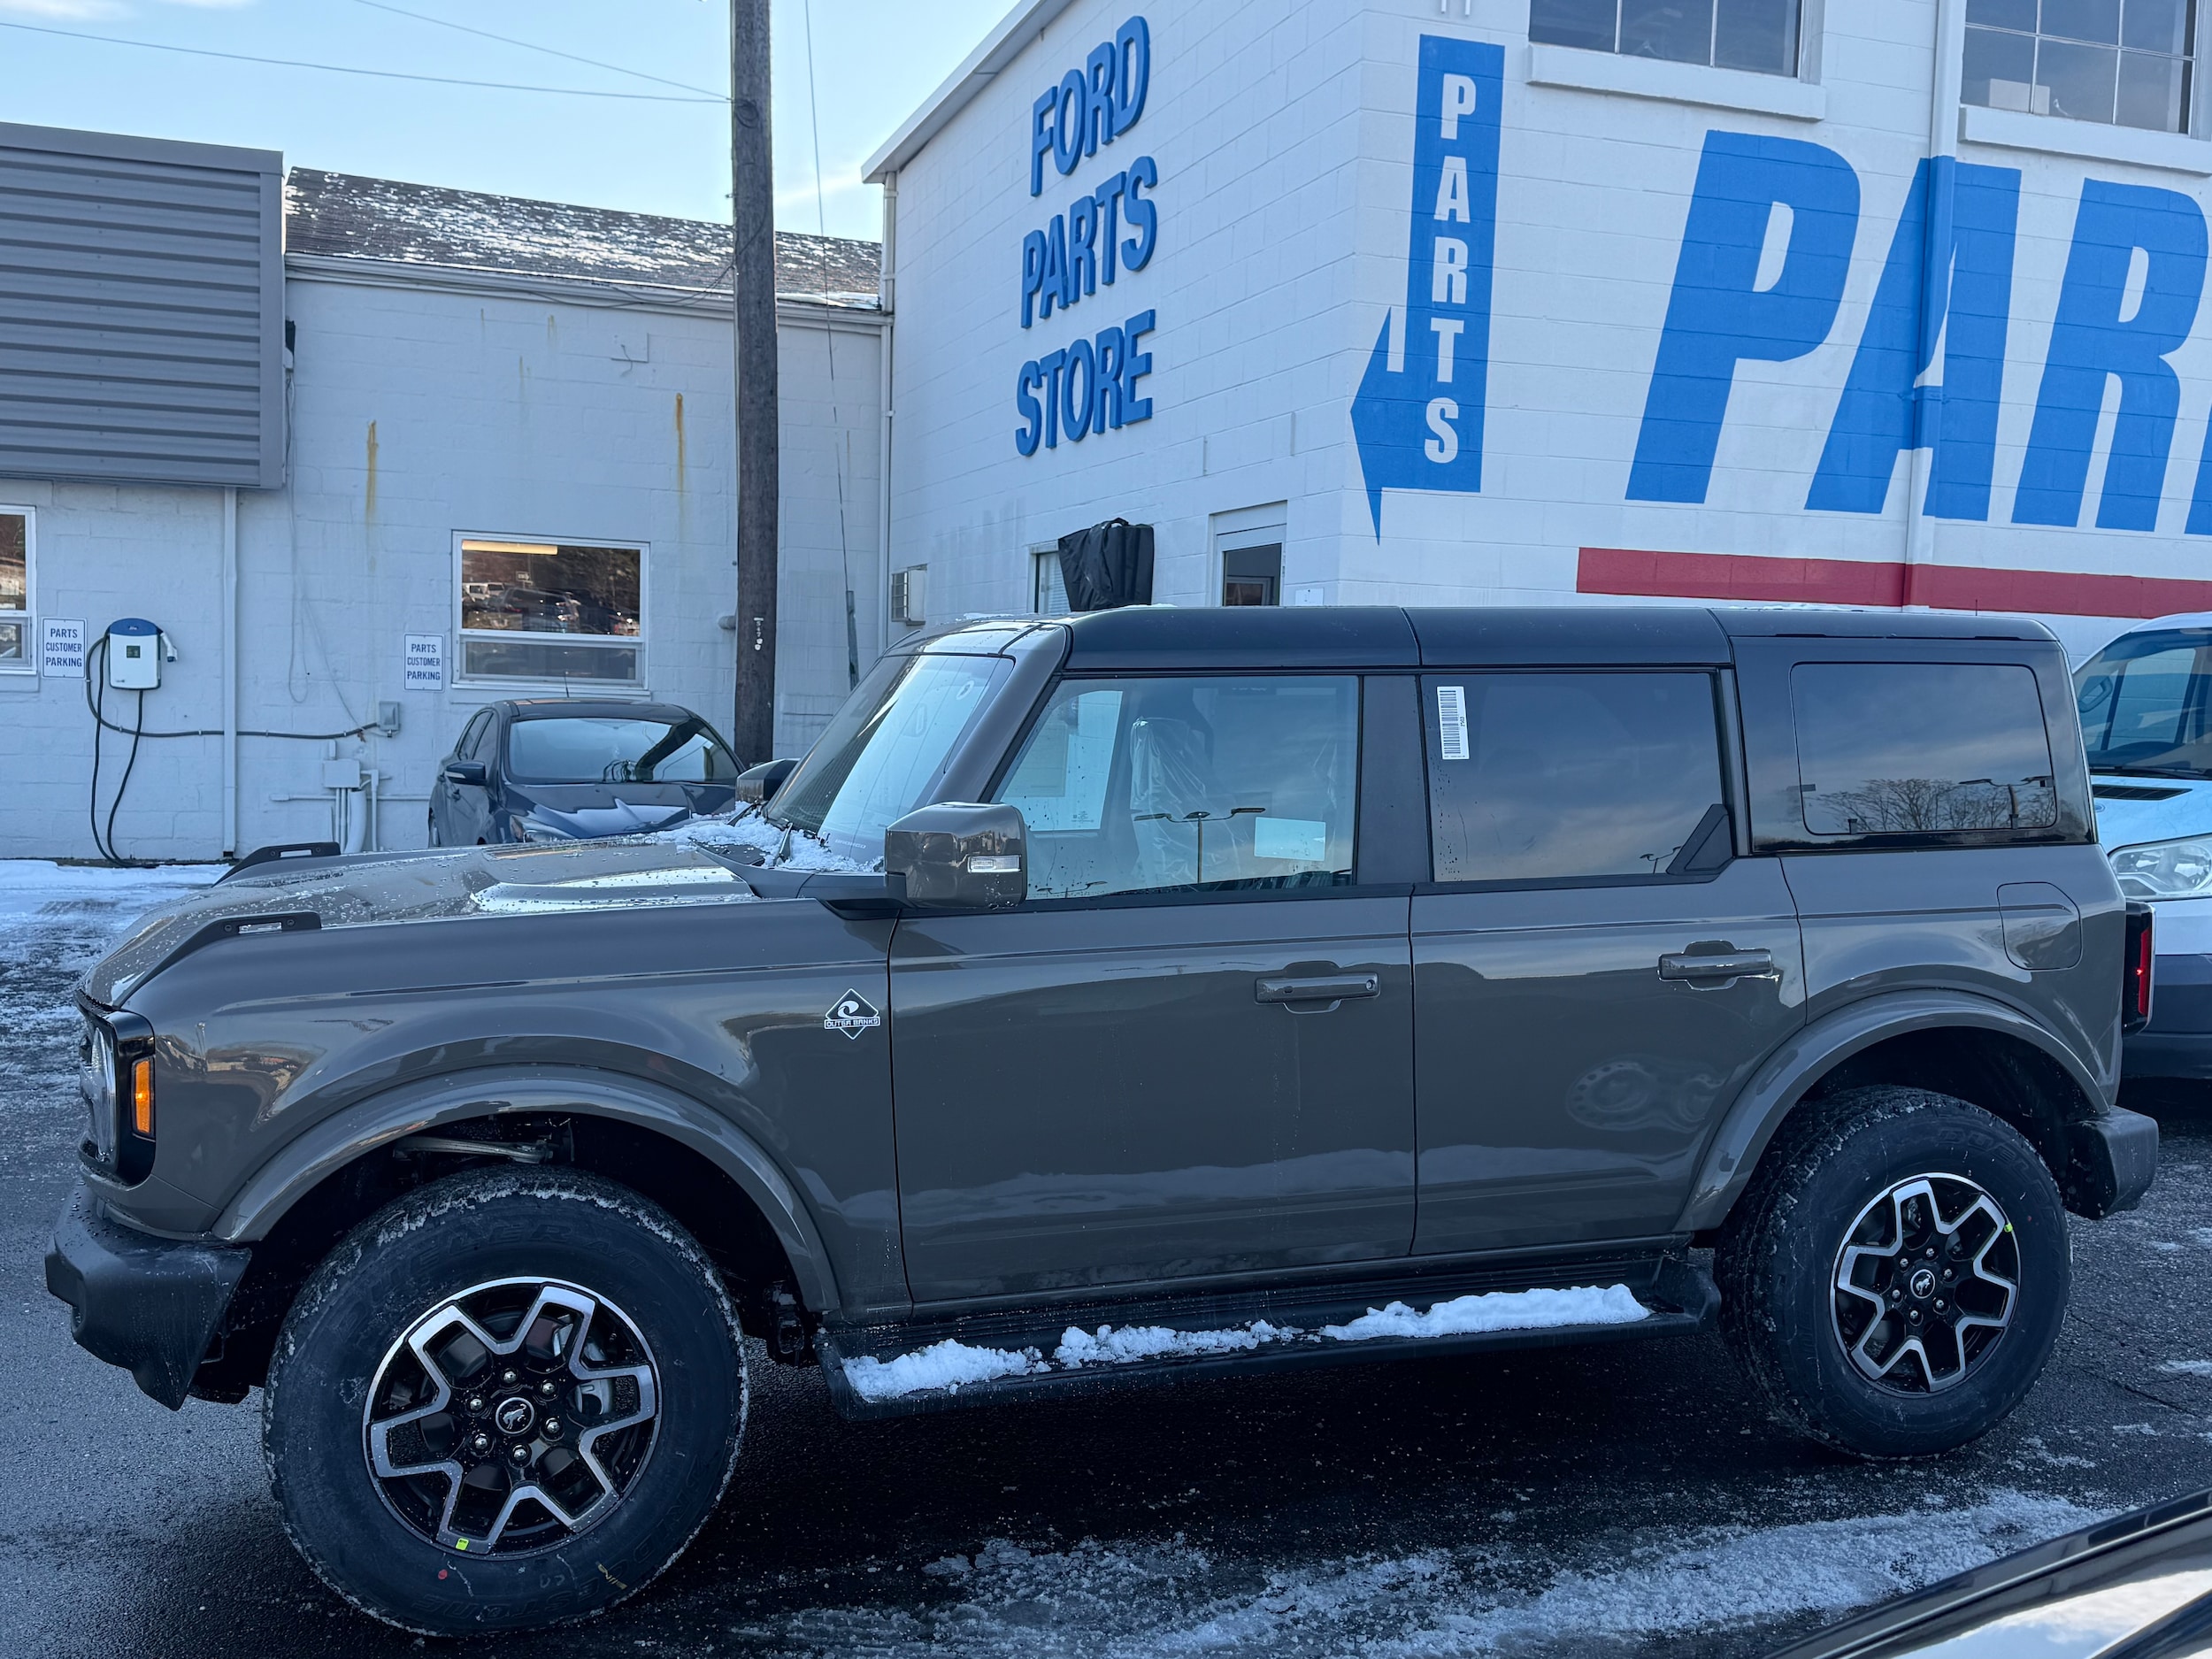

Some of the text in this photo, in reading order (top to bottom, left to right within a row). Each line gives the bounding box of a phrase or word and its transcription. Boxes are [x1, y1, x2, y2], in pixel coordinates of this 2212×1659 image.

[1030, 15, 1149, 196] FORD
[1020, 156, 1157, 328] PARTS
[1424, 73, 1476, 464] PARTS
[1624, 130, 2212, 535] PAR
[1015, 309, 1156, 457] STORE
[50, 628, 78, 638] PARTS
[45, 642, 82, 652] CUSTOMER
[411, 643, 437, 653] PARTS
[45, 657, 82, 667] PARKING
[407, 657, 441, 666] CUSTOMER
[407, 671, 441, 680] PARKING
